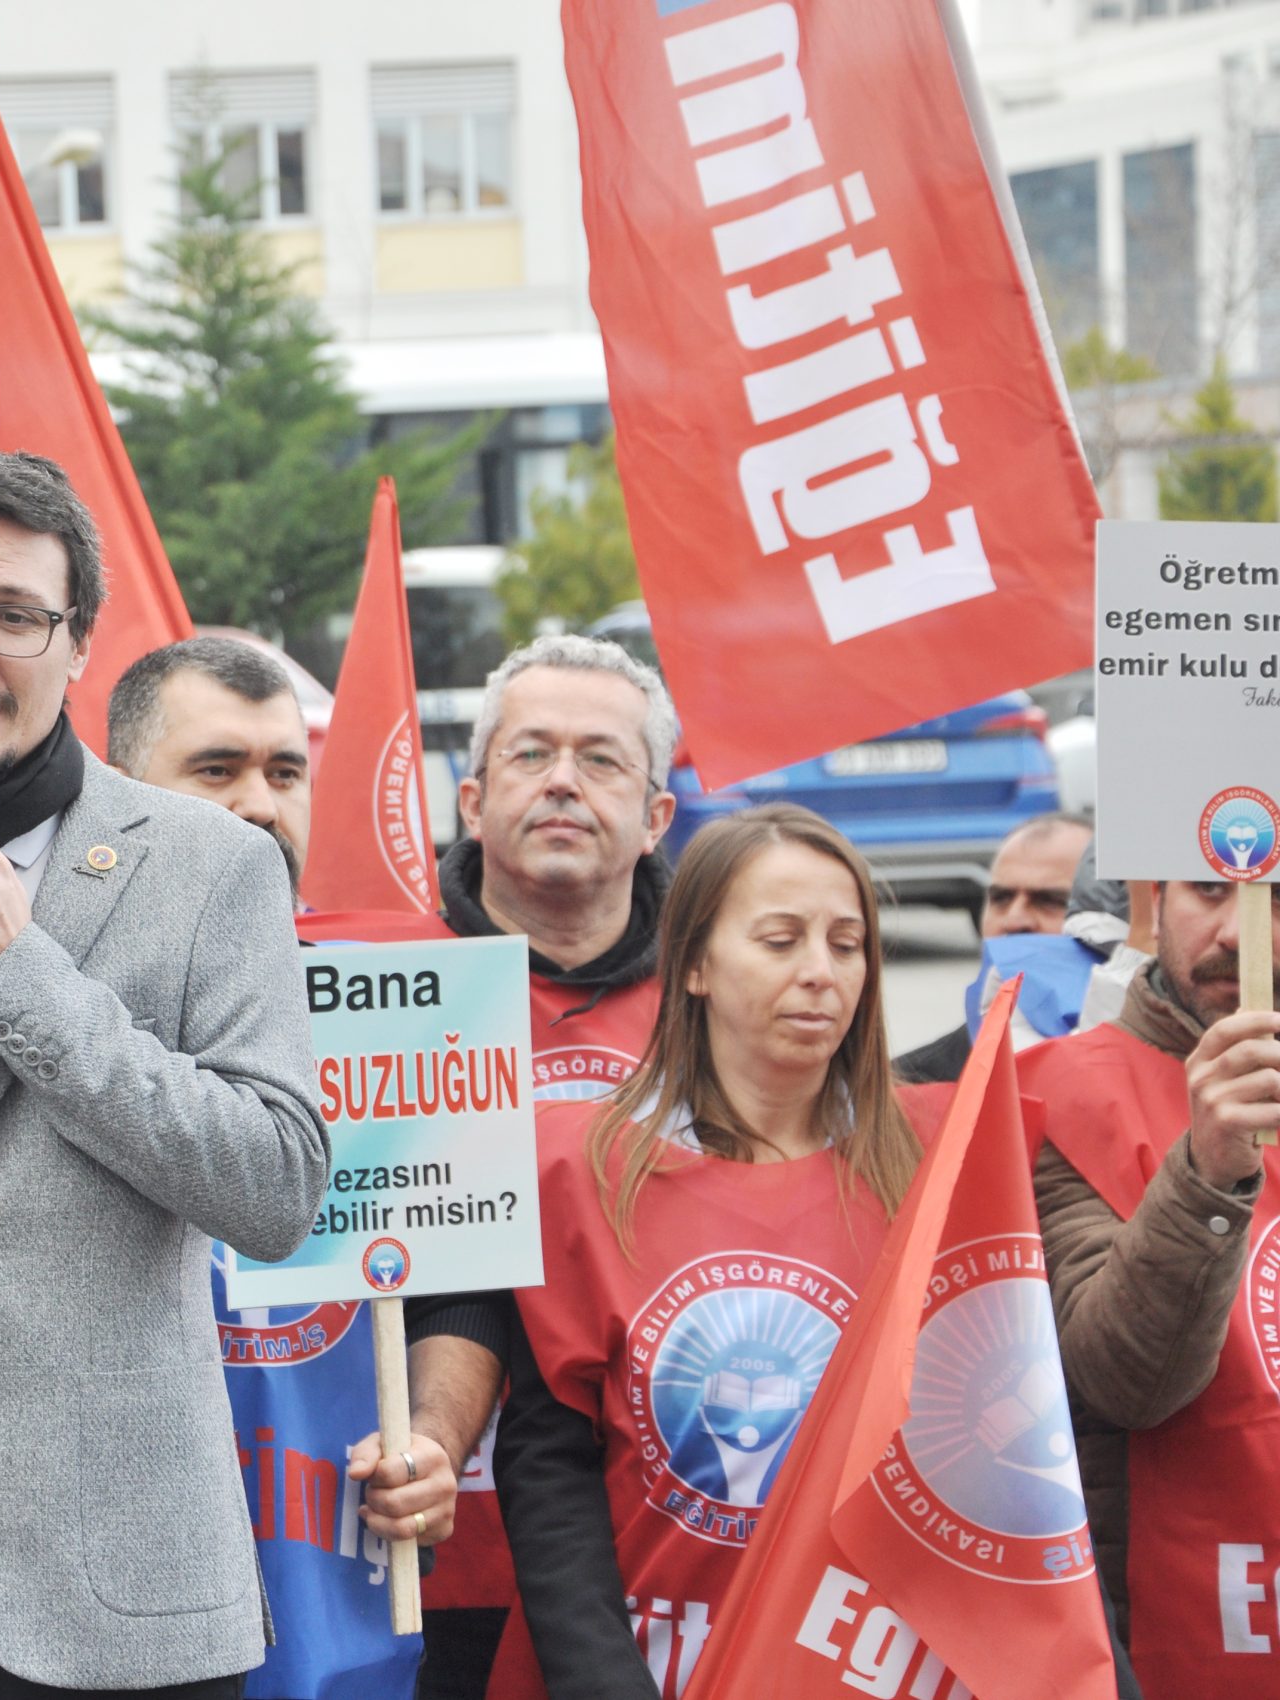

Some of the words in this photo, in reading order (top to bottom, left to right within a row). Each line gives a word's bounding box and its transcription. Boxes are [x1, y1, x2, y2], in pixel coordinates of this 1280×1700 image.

[1105, 607, 1232, 636] egemen
[1099, 652, 1169, 677] emir
[1180, 653, 1248, 678] kulu
[304, 964, 442, 1014] Bana
[315, 1033, 519, 1122] SUZLUĞUN
[327, 1162, 452, 1193] ezasını
[406, 1190, 518, 1230] misin?
[1258, 1285, 1276, 1314] VE
[631, 1345, 650, 1375] VE
[641, 1280, 696, 1343] BİLİM
[699, 1259, 851, 1322] İŞGÖRENLE
[221, 1323, 328, 1361] İTİM-İŞ
[729, 1357, 776, 1372] 2005
